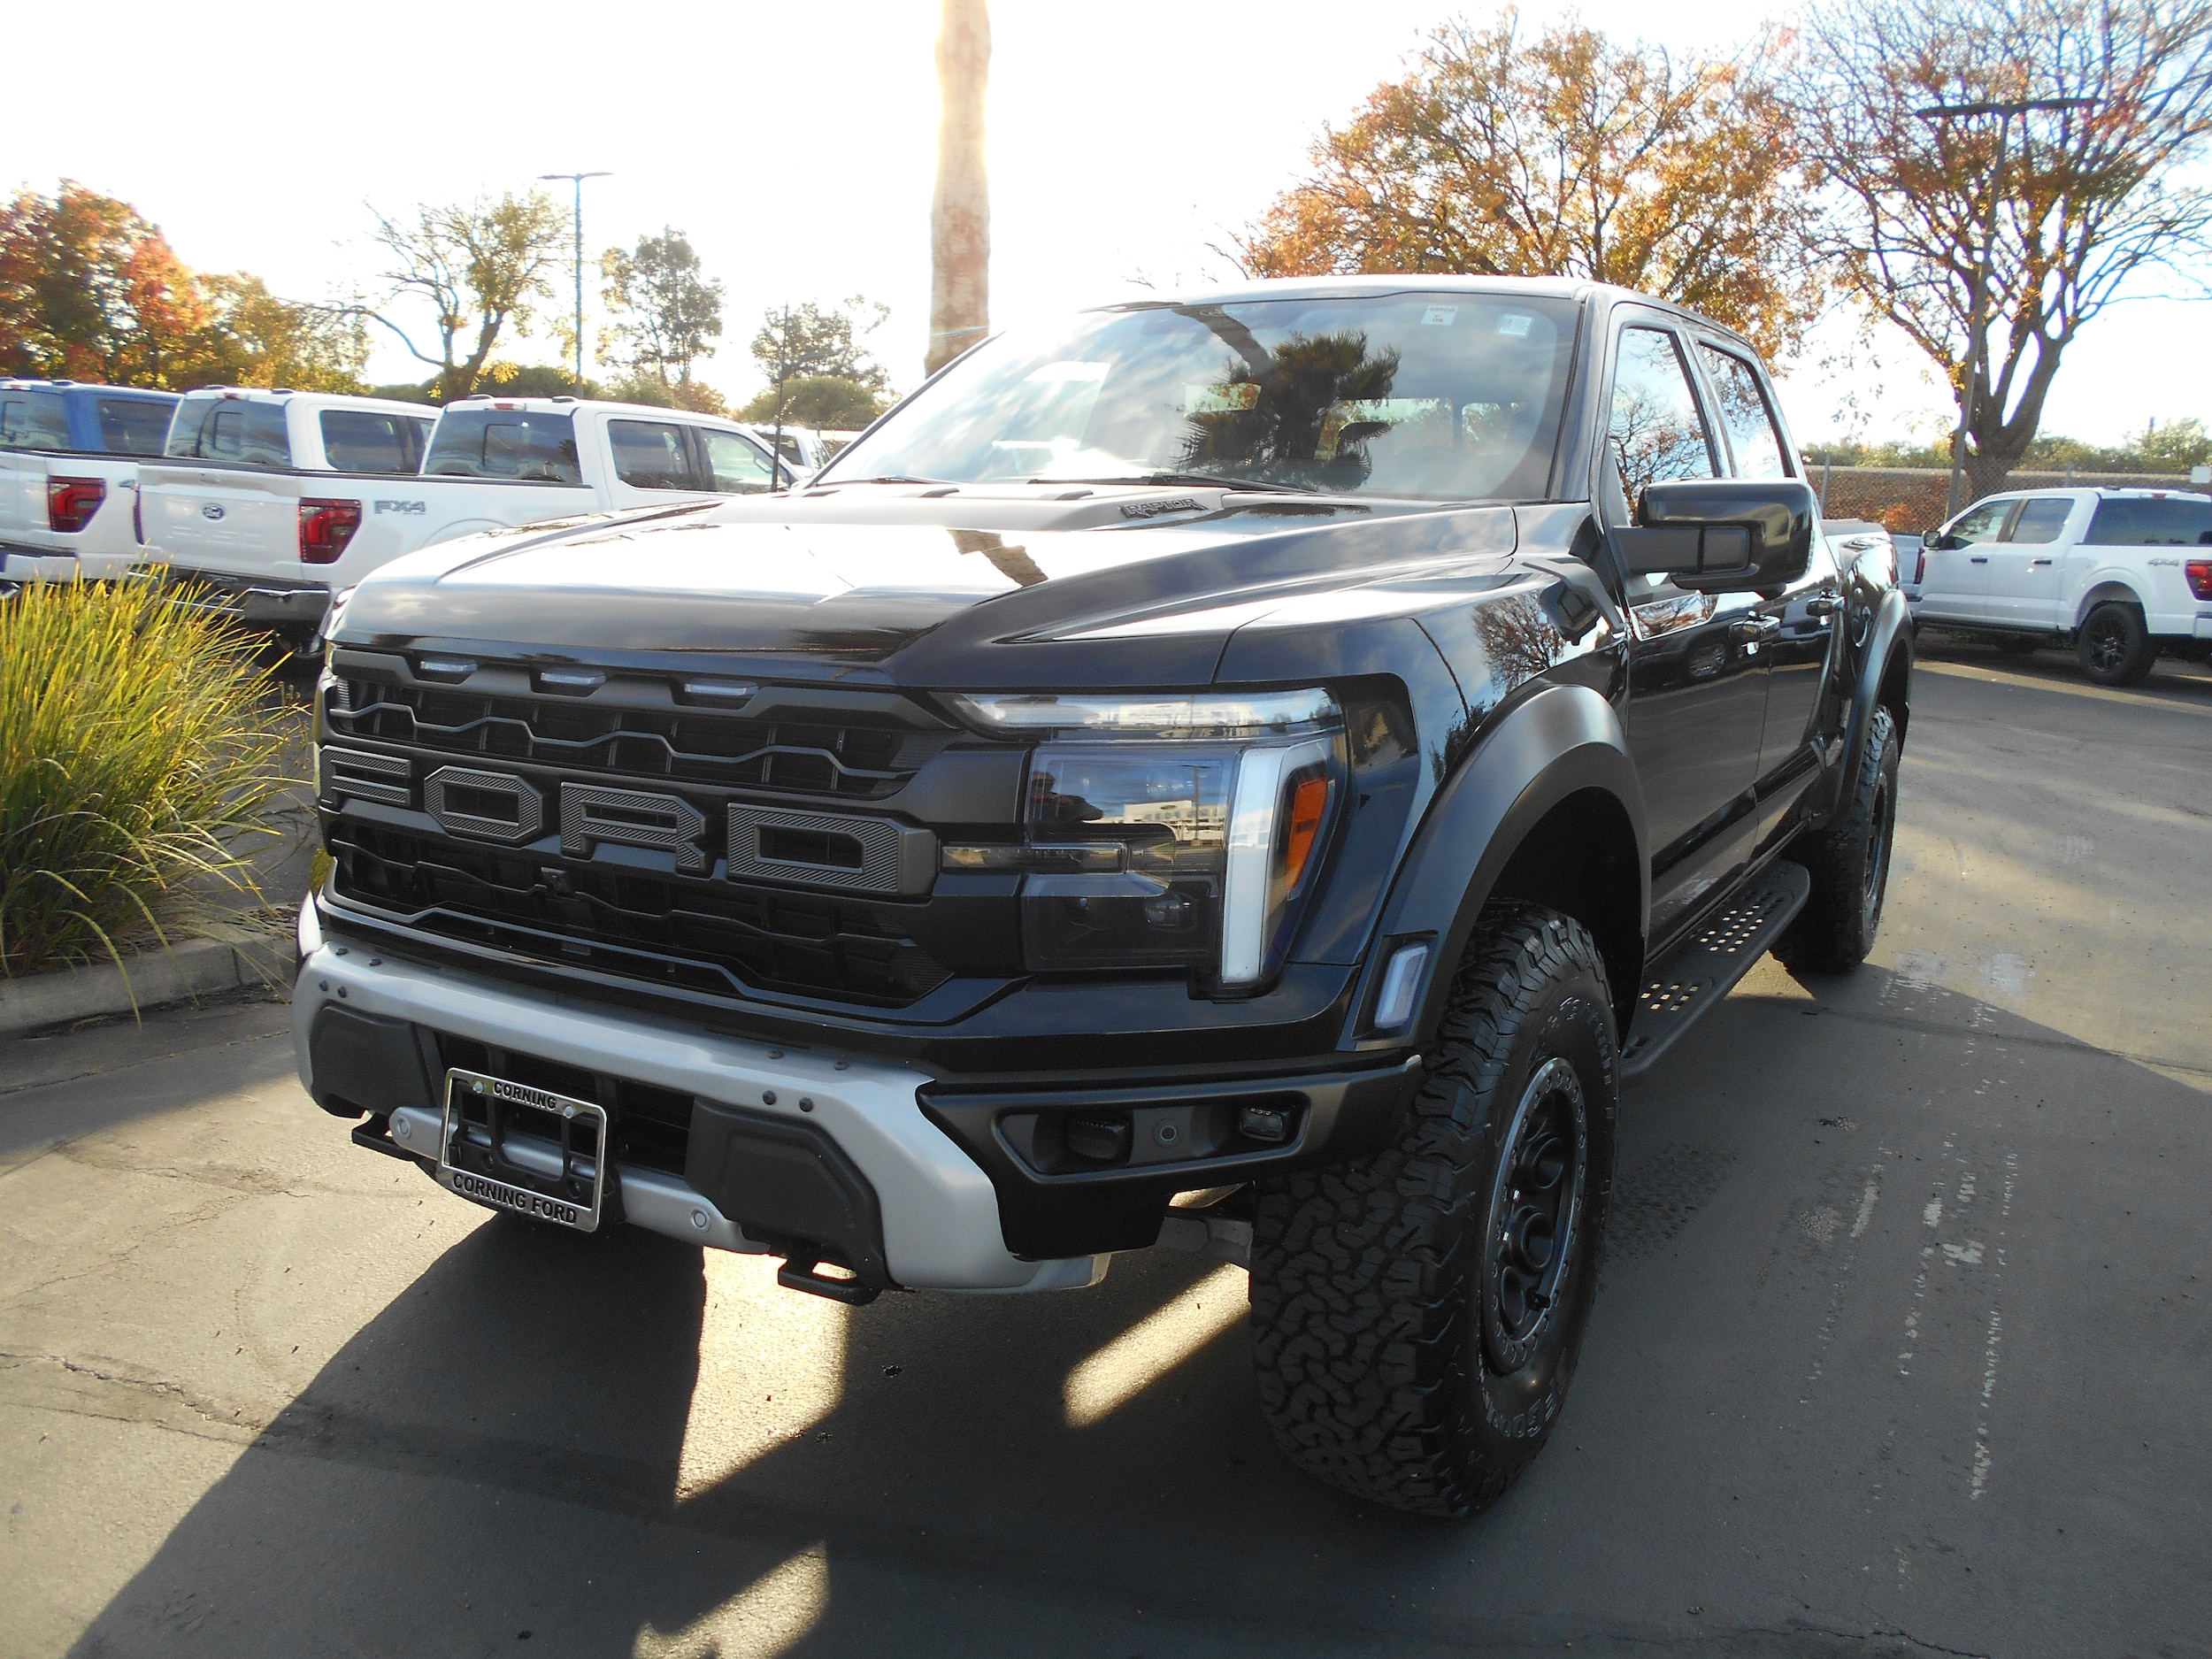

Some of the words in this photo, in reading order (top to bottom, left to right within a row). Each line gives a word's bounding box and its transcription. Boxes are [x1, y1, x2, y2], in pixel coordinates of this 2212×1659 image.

[373, 499, 426, 514] FX4
[1121, 498, 1208, 518] RAPTOR
[319, 744, 937, 895] FORD
[492, 1081, 557, 1110] CORNING
[452, 1173, 526, 1210] CORNING
[531, 1198, 577, 1225] FORD
